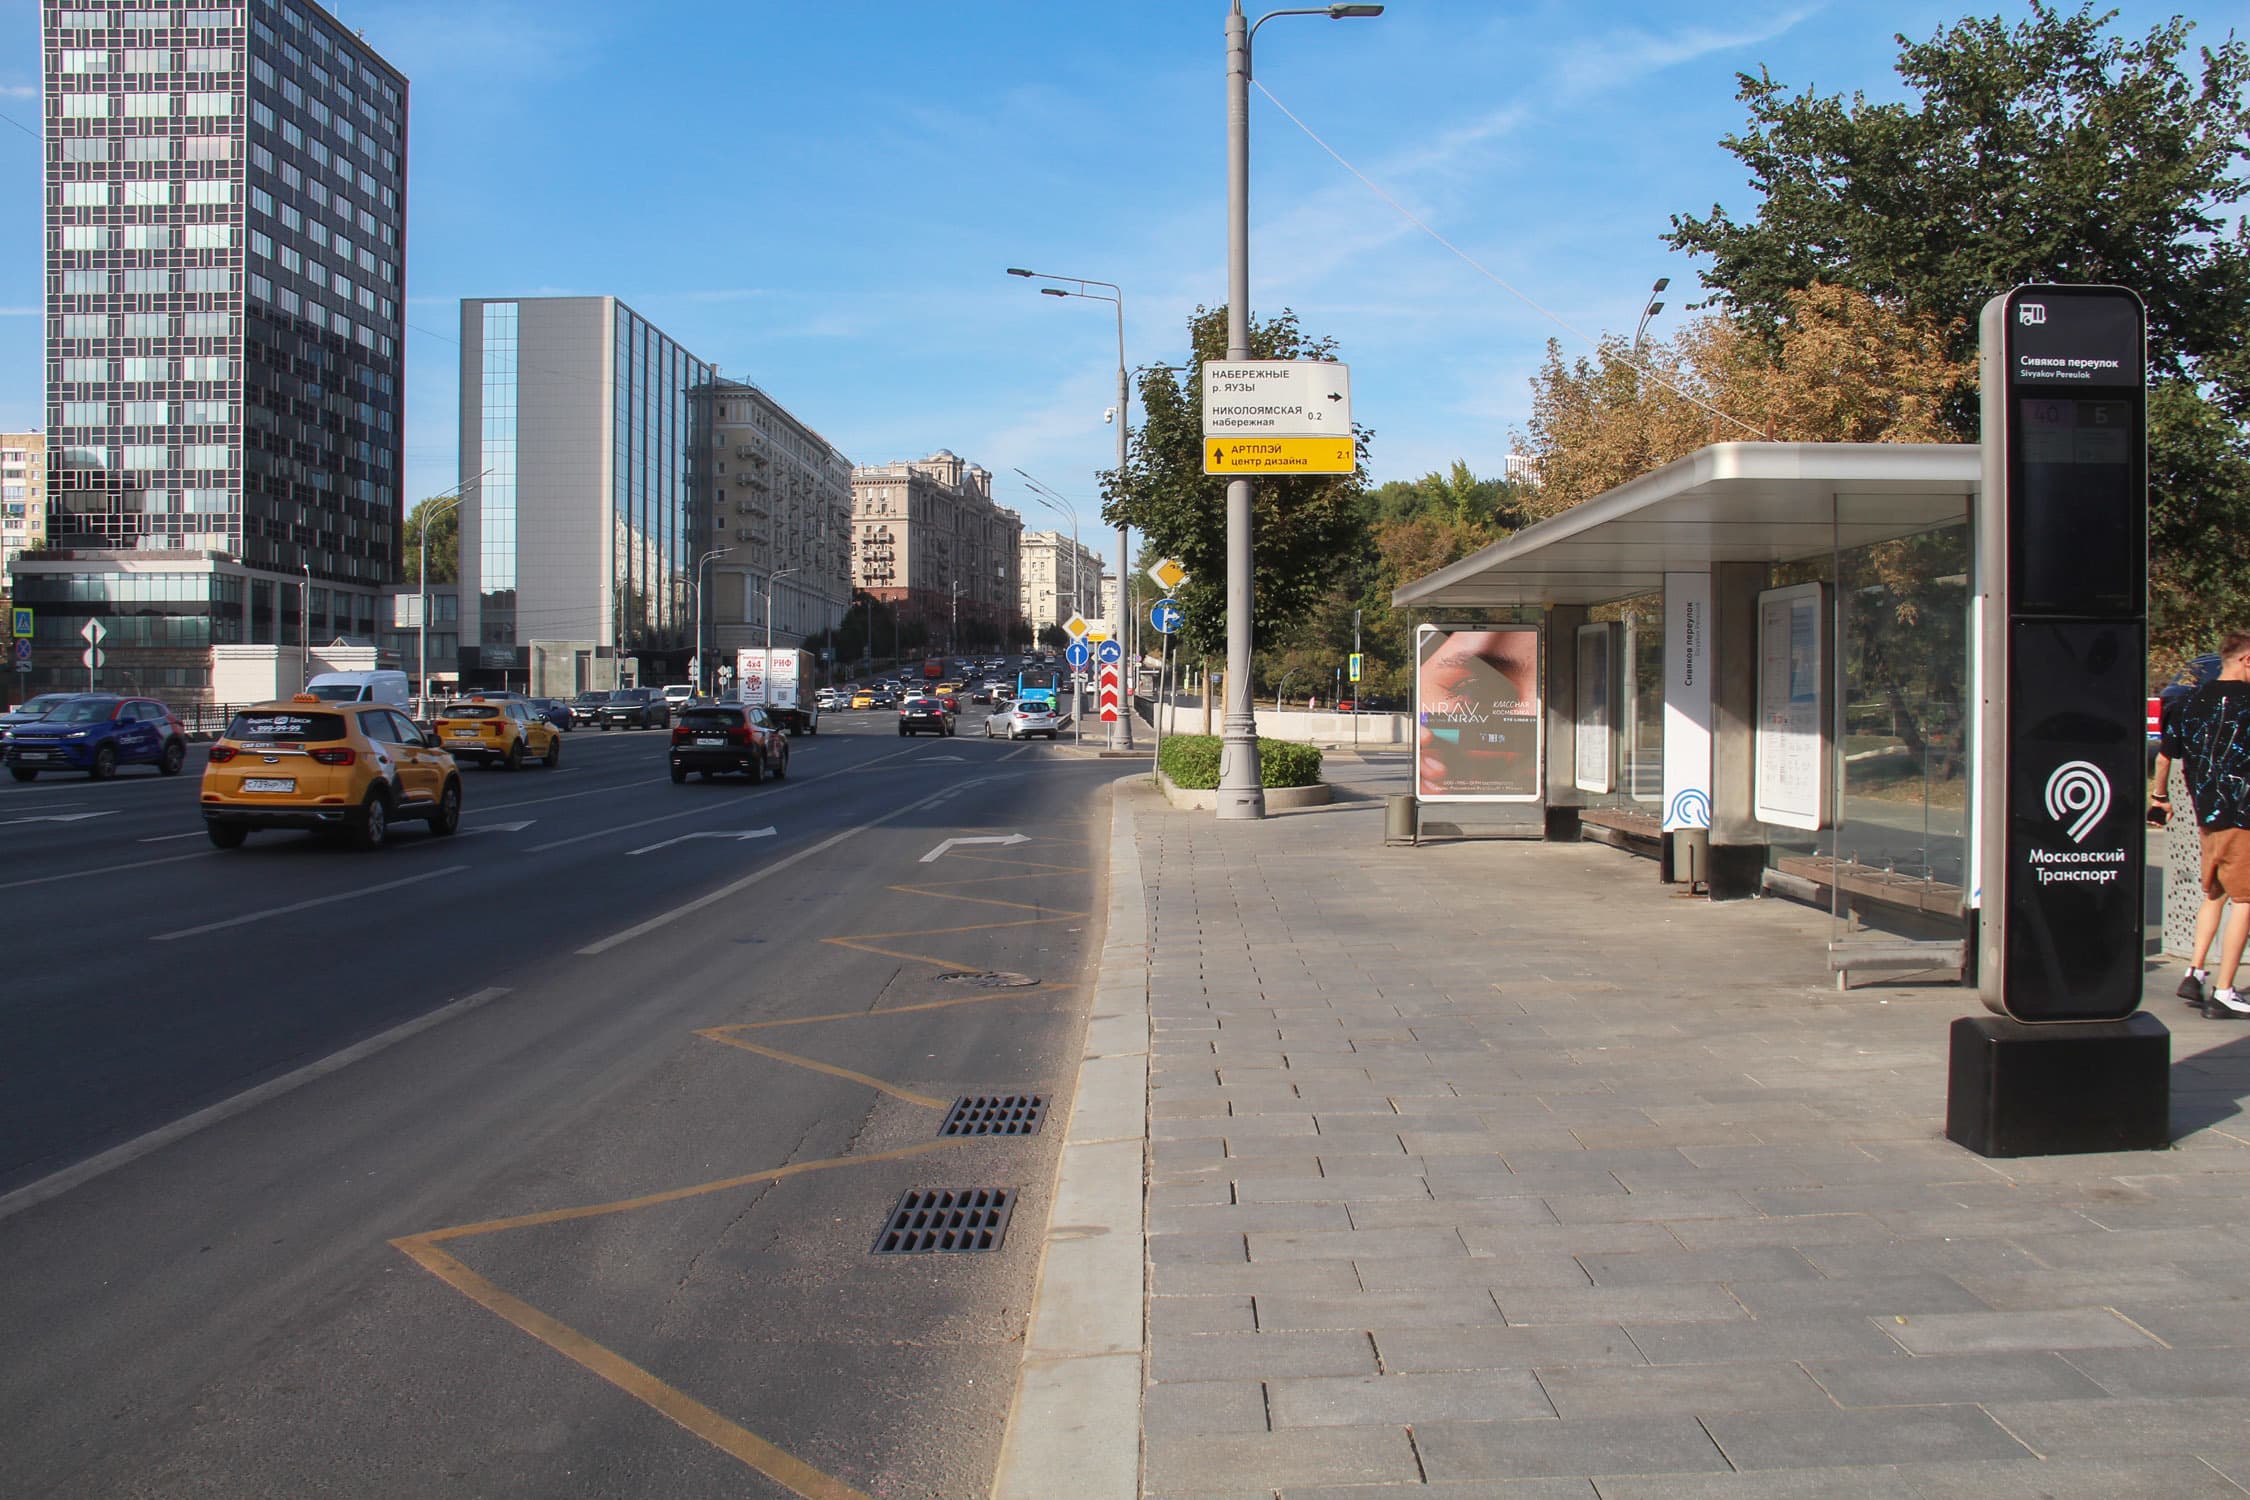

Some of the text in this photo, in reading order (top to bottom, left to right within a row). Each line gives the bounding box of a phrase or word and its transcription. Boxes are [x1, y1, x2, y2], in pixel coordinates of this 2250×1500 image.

[2020, 355, 2119, 370] Сивяков переулок
[1212, 370, 1290, 379] НАБЕРЕЖНЫЕ
[2020, 369, 2091, 379] Sivyakov Pereulok
[1212, 383, 1255, 394] р. ЯУЗЫ
[1212, 406, 1302, 415] НИКОЛОЯМСКАЯ
[1307, 412, 1322, 420] 0.2
[1212, 418, 1275, 428] набережная
[1231, 444, 1282, 454] АРТПЛЭЙ
[1337, 451, 1350, 459] 2.1
[1231, 457, 1308, 466] центр дизайна
[773, 659, 792, 667] РИФ
[1422, 701, 1480, 716] NRAV
[1447, 714, 1489, 723] NRAV
[2029, 848, 2126, 864] Московский
[2036, 867, 2118, 886] Транспорт
